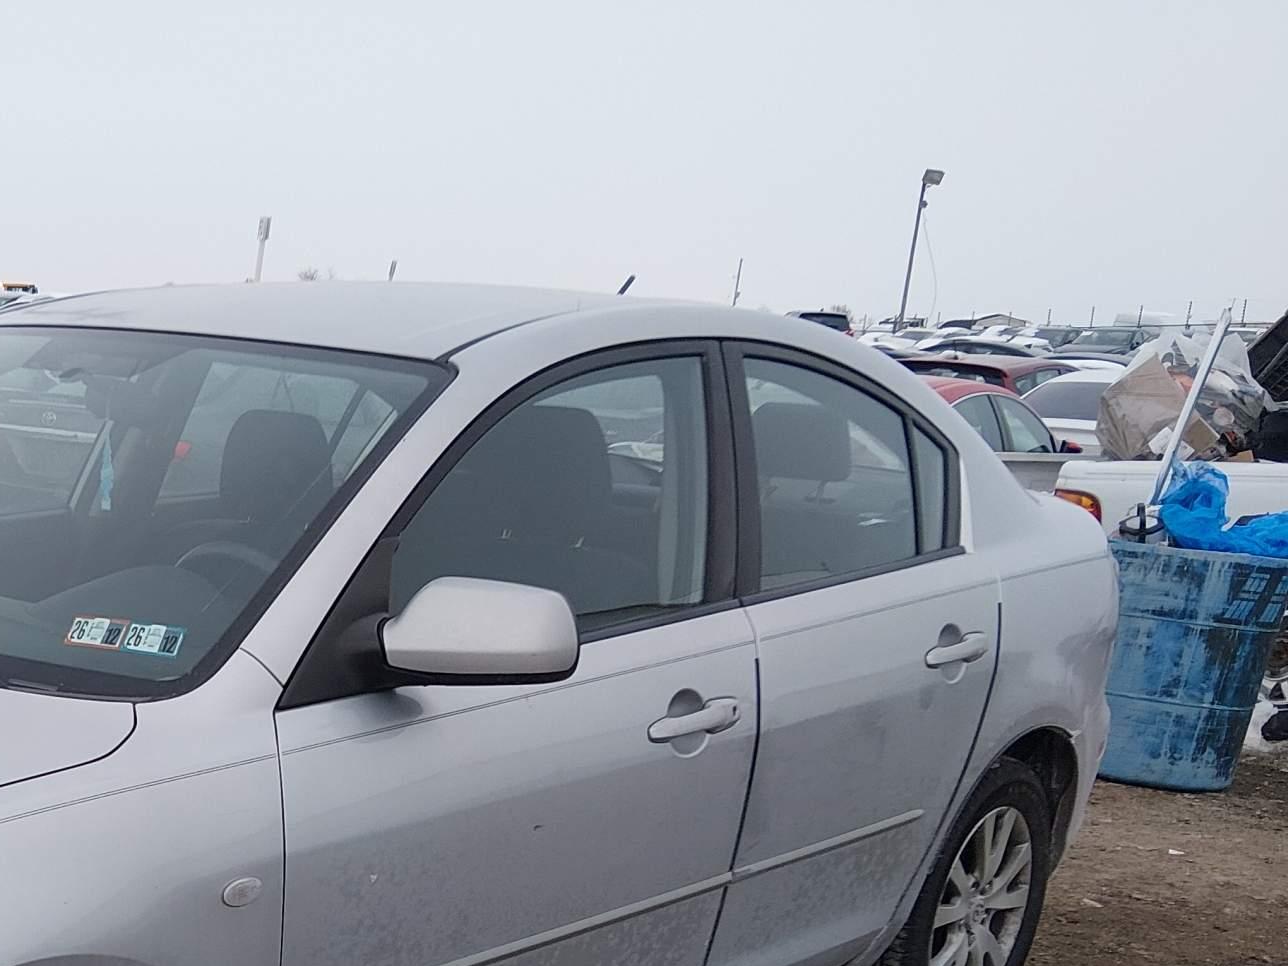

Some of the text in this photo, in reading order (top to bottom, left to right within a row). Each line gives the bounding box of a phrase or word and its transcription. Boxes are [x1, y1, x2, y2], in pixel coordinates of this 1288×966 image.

[71, 620, 89, 640] 26
[104, 627, 121, 645] 12
[127, 626, 145, 647] 26
[162, 635, 178, 653] 12
